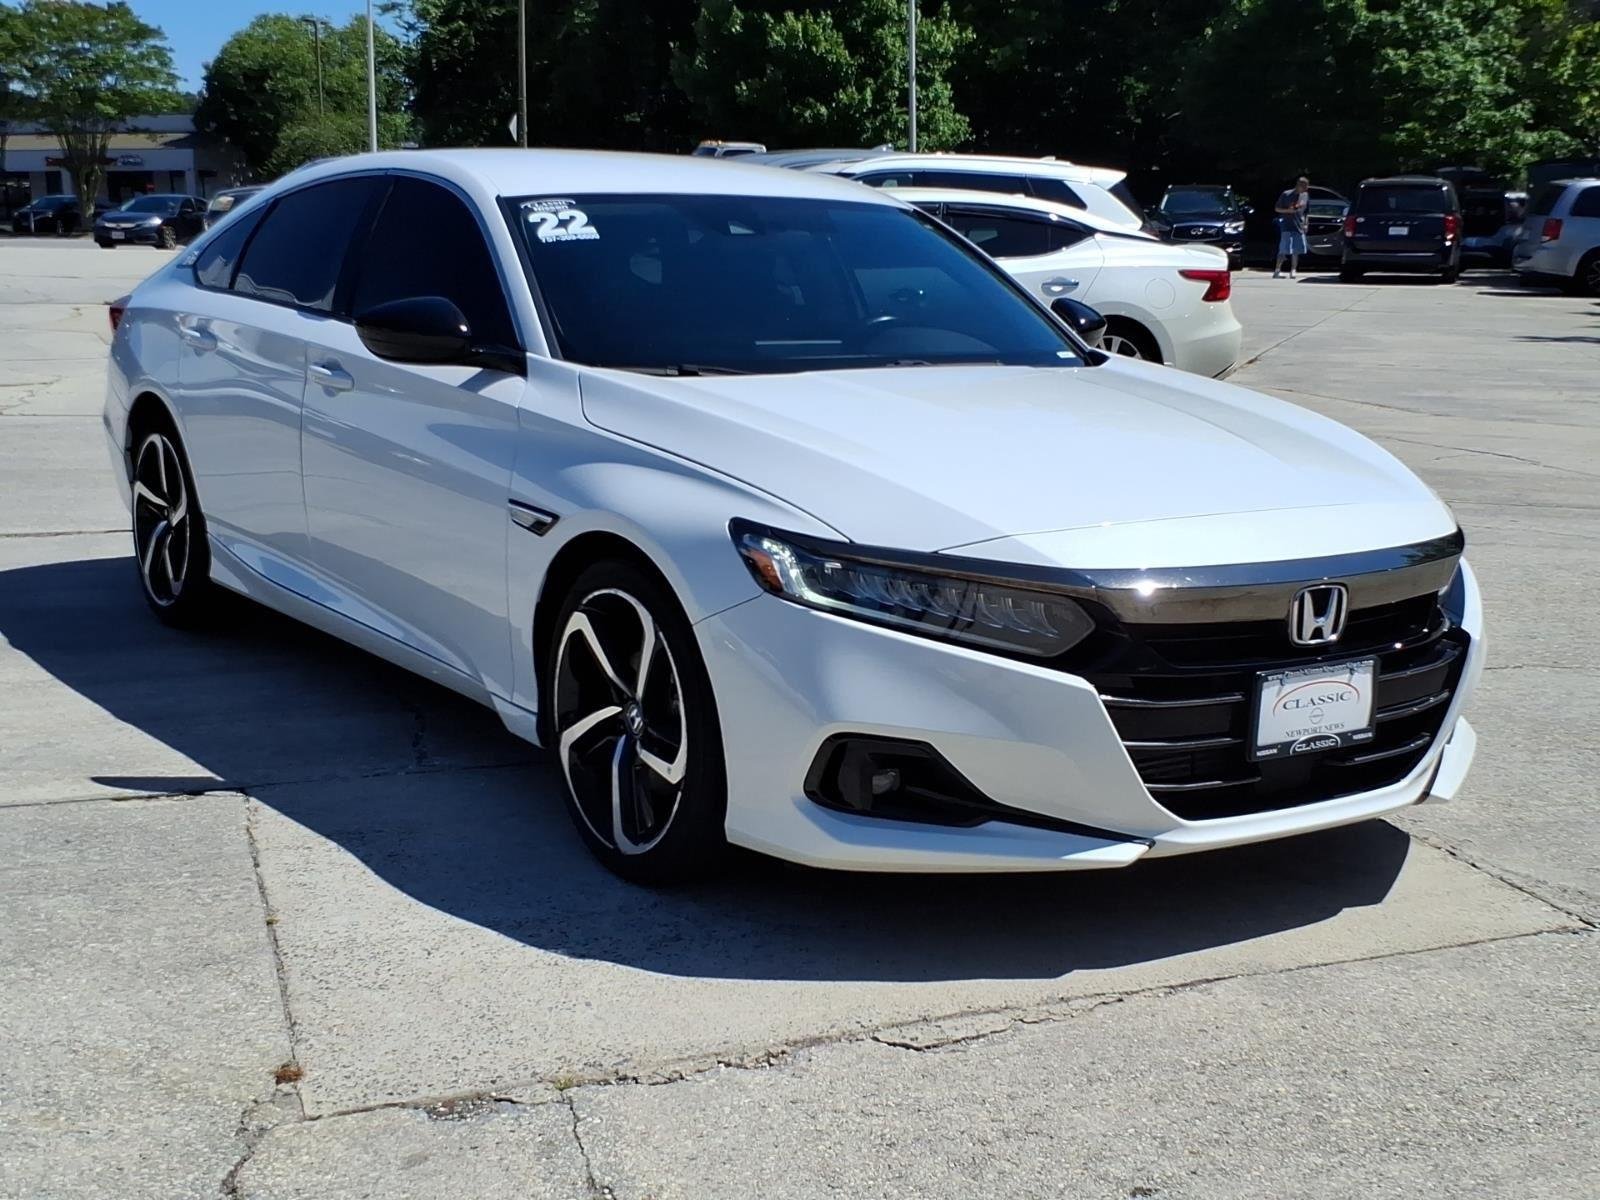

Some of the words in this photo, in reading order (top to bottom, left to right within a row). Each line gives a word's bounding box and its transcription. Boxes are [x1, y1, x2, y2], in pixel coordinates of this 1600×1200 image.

[528, 209, 599, 239] 22
[1282, 691, 1352, 710] CLASSIC
[1285, 726, 1322, 738] NEWPORT
[1324, 722, 1345, 732] NEWS
[1294, 738, 1337, 752] CLASSIC
